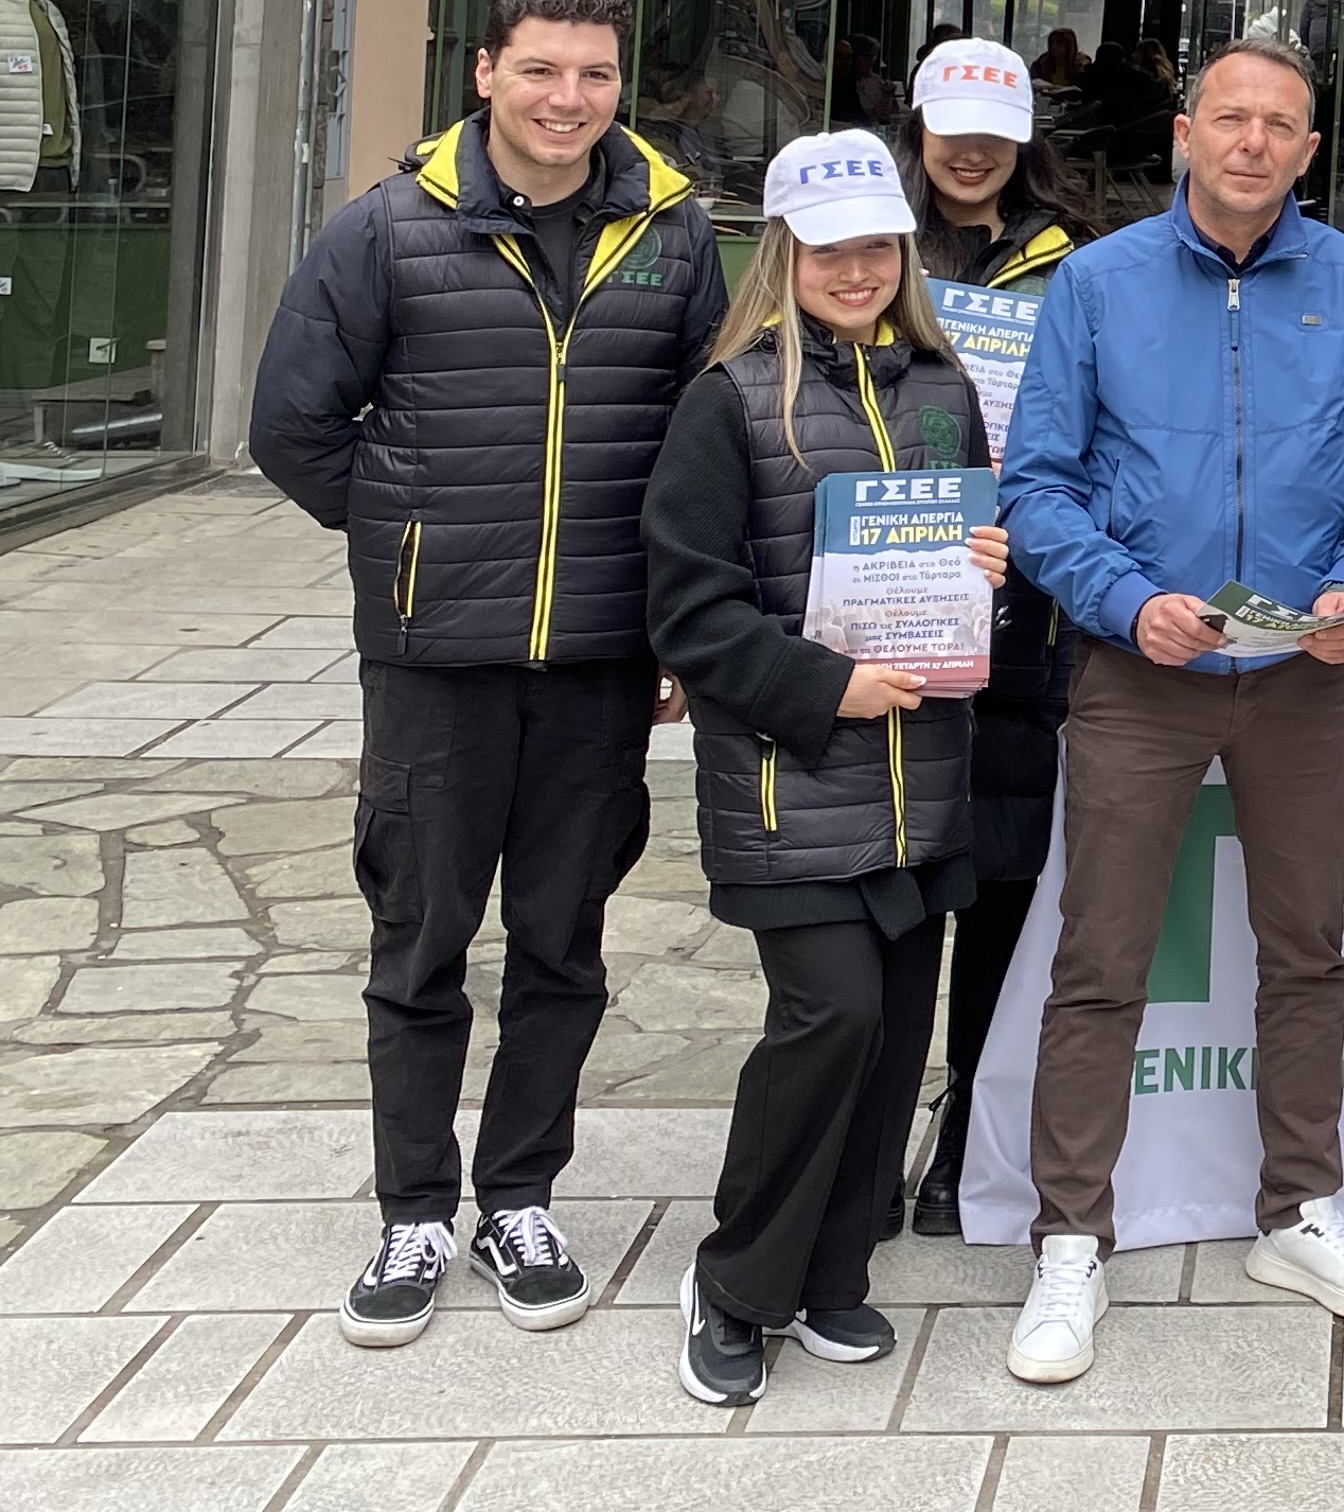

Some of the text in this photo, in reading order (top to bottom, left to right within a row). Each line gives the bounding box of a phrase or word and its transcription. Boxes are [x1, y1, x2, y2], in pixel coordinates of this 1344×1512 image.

[942, 65, 1018, 88] ΓΣΕΕ
[800, 160, 883, 184] ΓΣΕΕ
[943, 288, 1039, 321] ΓΣΕΕ
[943, 320, 986, 334] ΓΕΝΙΚΗ
[963, 334, 1031, 357] ΑΠΡΙΛΗ
[856, 477, 961, 501] ΓΣΕΕ
[862, 512, 964, 527] ΓΕΝΙΚΗ ΑΠΕΡΓΙΑ
[861, 525, 962, 545] 17 ΑΠΡΙΛΗ
[862, 560, 916, 571] ΑΚΡΙΒΕΙΑ
[939, 558, 961, 567] Θεό
[864, 572, 899, 582] ΜΙΣΘΟΙ
[920, 570, 961, 581] Τάρταρα
[843, 594, 969, 606] ΠΡΑΓΜΑΤΙΚΕΣ ΑΥΞΗΣΕΙΣ
[851, 620, 877, 630] ΠΙΣΩ
[895, 618, 960, 629] ΣΥΛΛΟΓΙΚΕΣ
[885, 629, 943, 640] ΣΥΜΒΑΣΕΙΣ
[874, 643, 927, 653] ΘΕΛΟΥΜΕ
